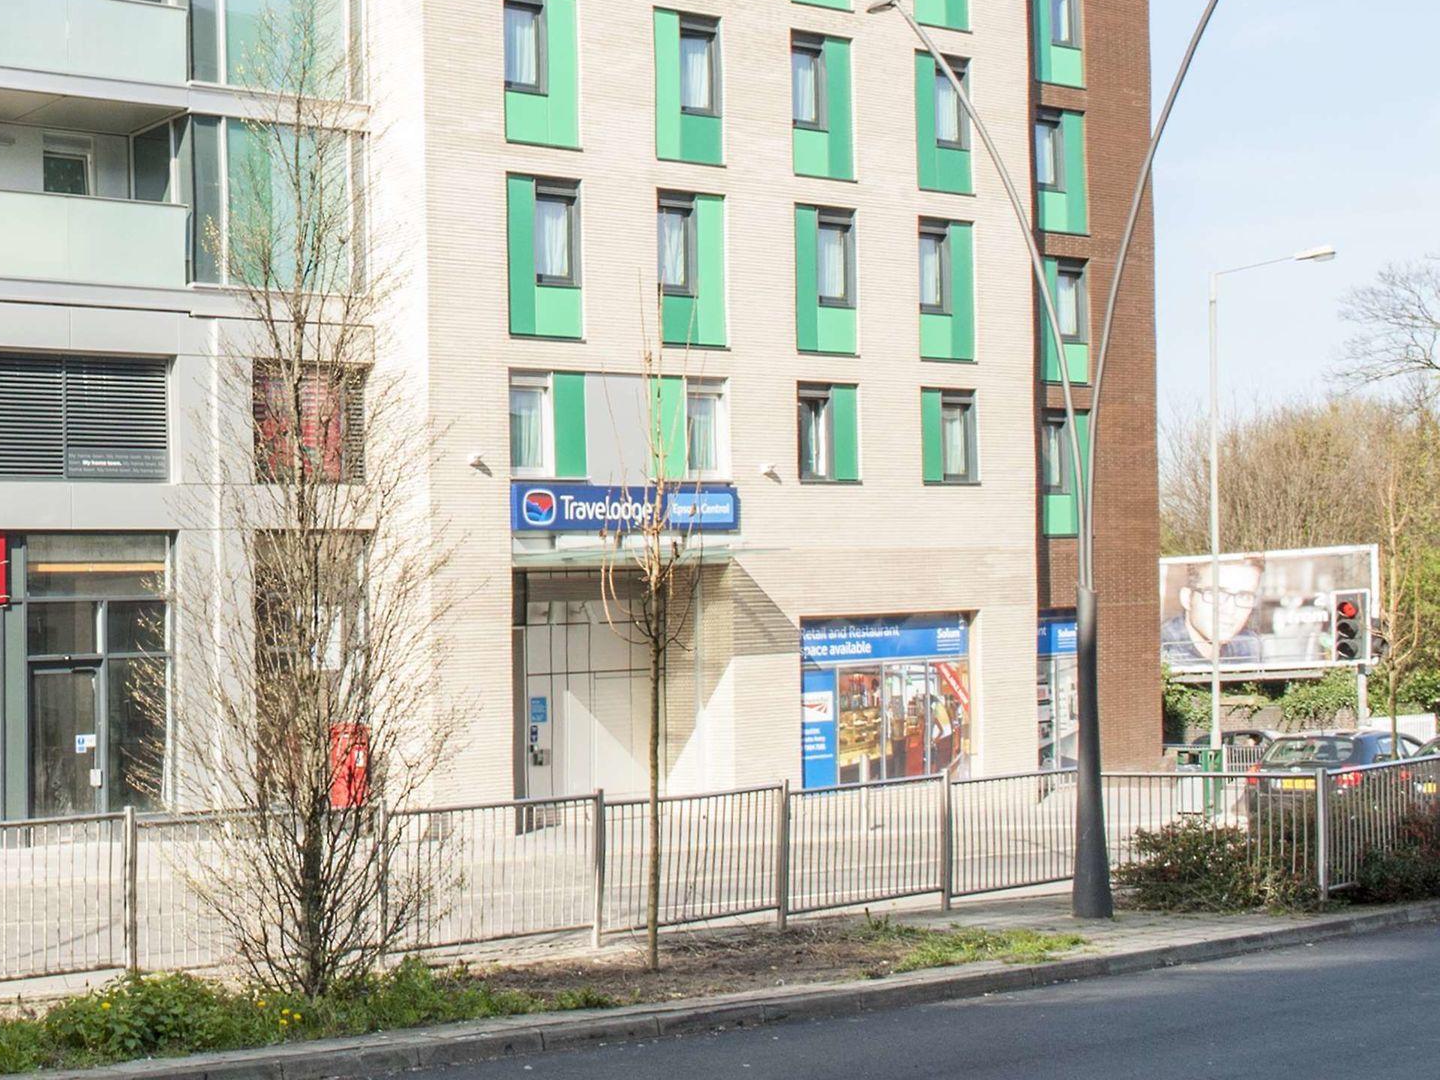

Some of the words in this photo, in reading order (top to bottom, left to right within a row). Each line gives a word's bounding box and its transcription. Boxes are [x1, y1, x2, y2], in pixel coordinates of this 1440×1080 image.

[560, 494, 653, 526] Travelodge
[828, 626, 847, 639] and
[849, 624, 900, 639] Restaurant
[829, 640, 872, 656] available
